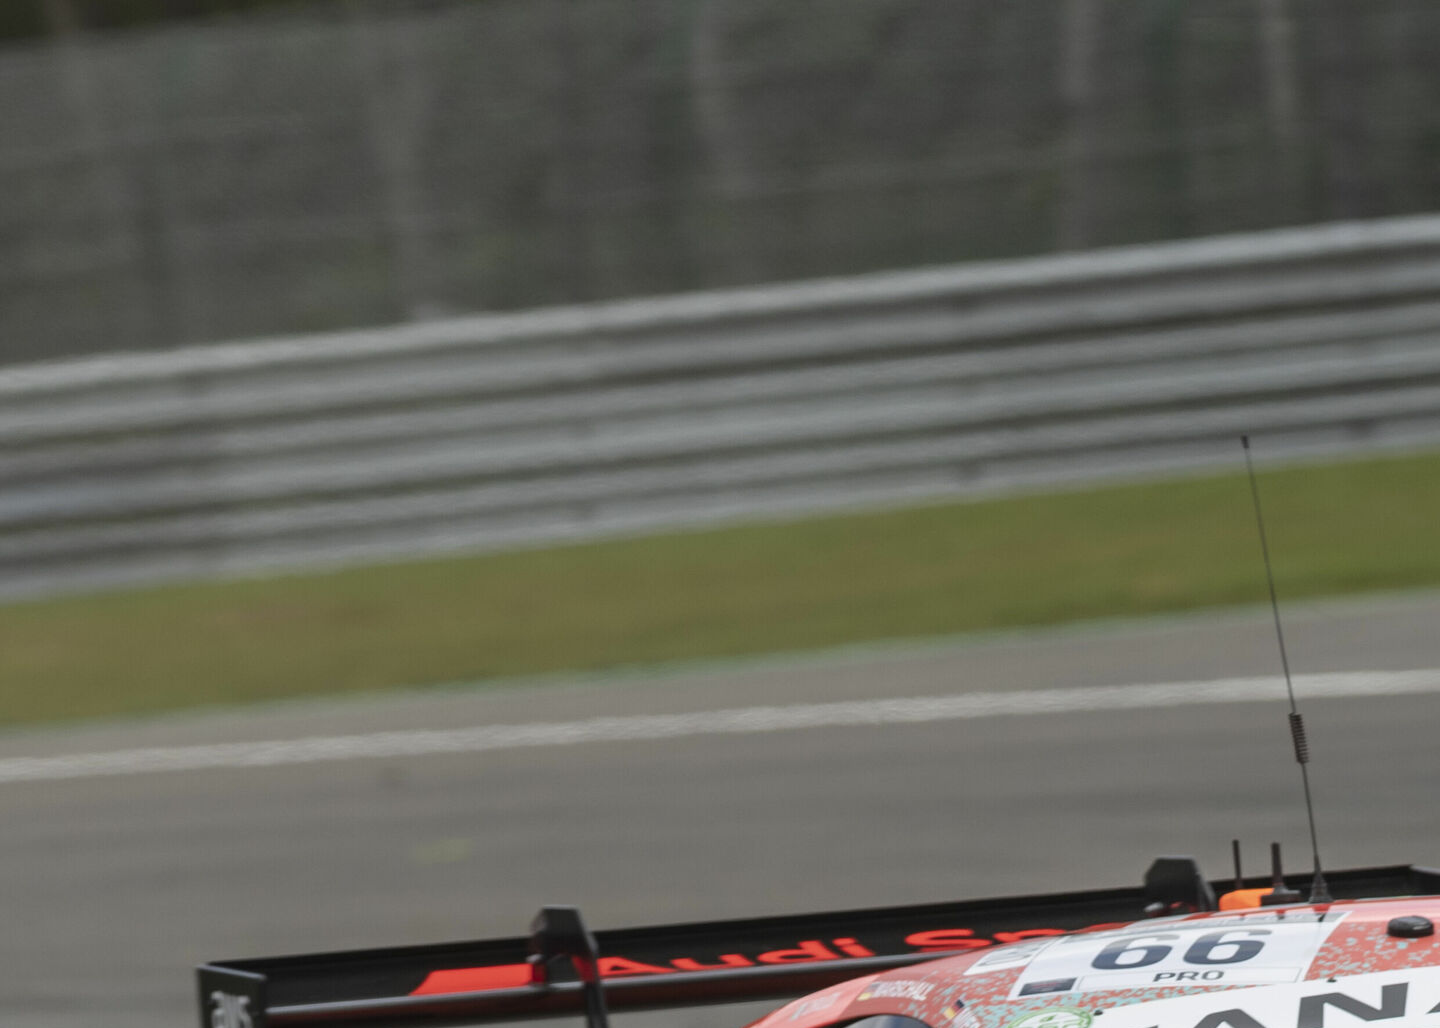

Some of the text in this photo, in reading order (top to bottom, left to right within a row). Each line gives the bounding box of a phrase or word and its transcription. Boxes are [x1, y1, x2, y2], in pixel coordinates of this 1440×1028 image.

[597, 937, 875, 977] Audi
[1090, 929, 1272, 970] 66
[1152, 970, 1226, 993] PRO
